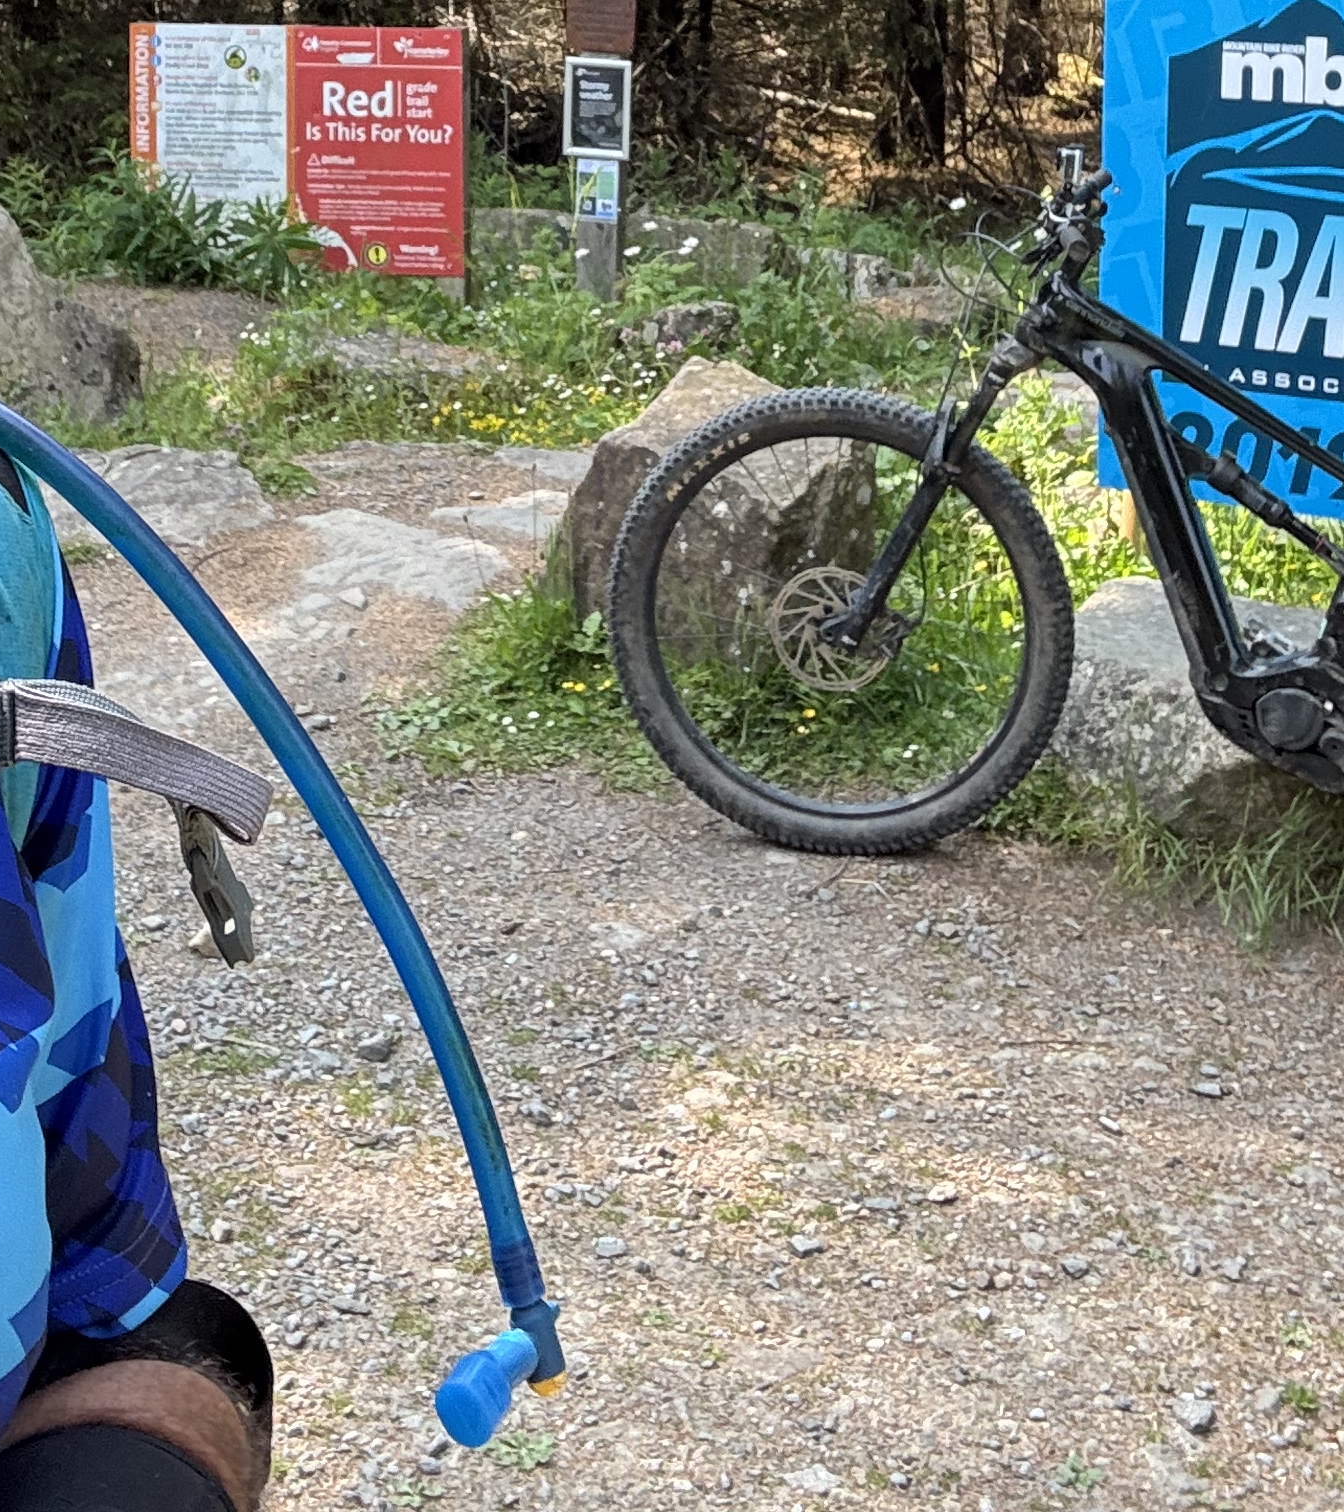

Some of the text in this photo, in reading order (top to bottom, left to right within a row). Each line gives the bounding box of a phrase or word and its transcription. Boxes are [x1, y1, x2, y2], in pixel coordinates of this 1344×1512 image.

[135, 34, 151, 153] INFORMATION
[322, 80, 394, 118] Red
[406, 81, 438, 96] grade
[406, 95, 429, 107] trail
[406, 107, 433, 119] start
[306, 121, 454, 144] Is This For You?
[666, 432, 751, 502] MAXXIS
